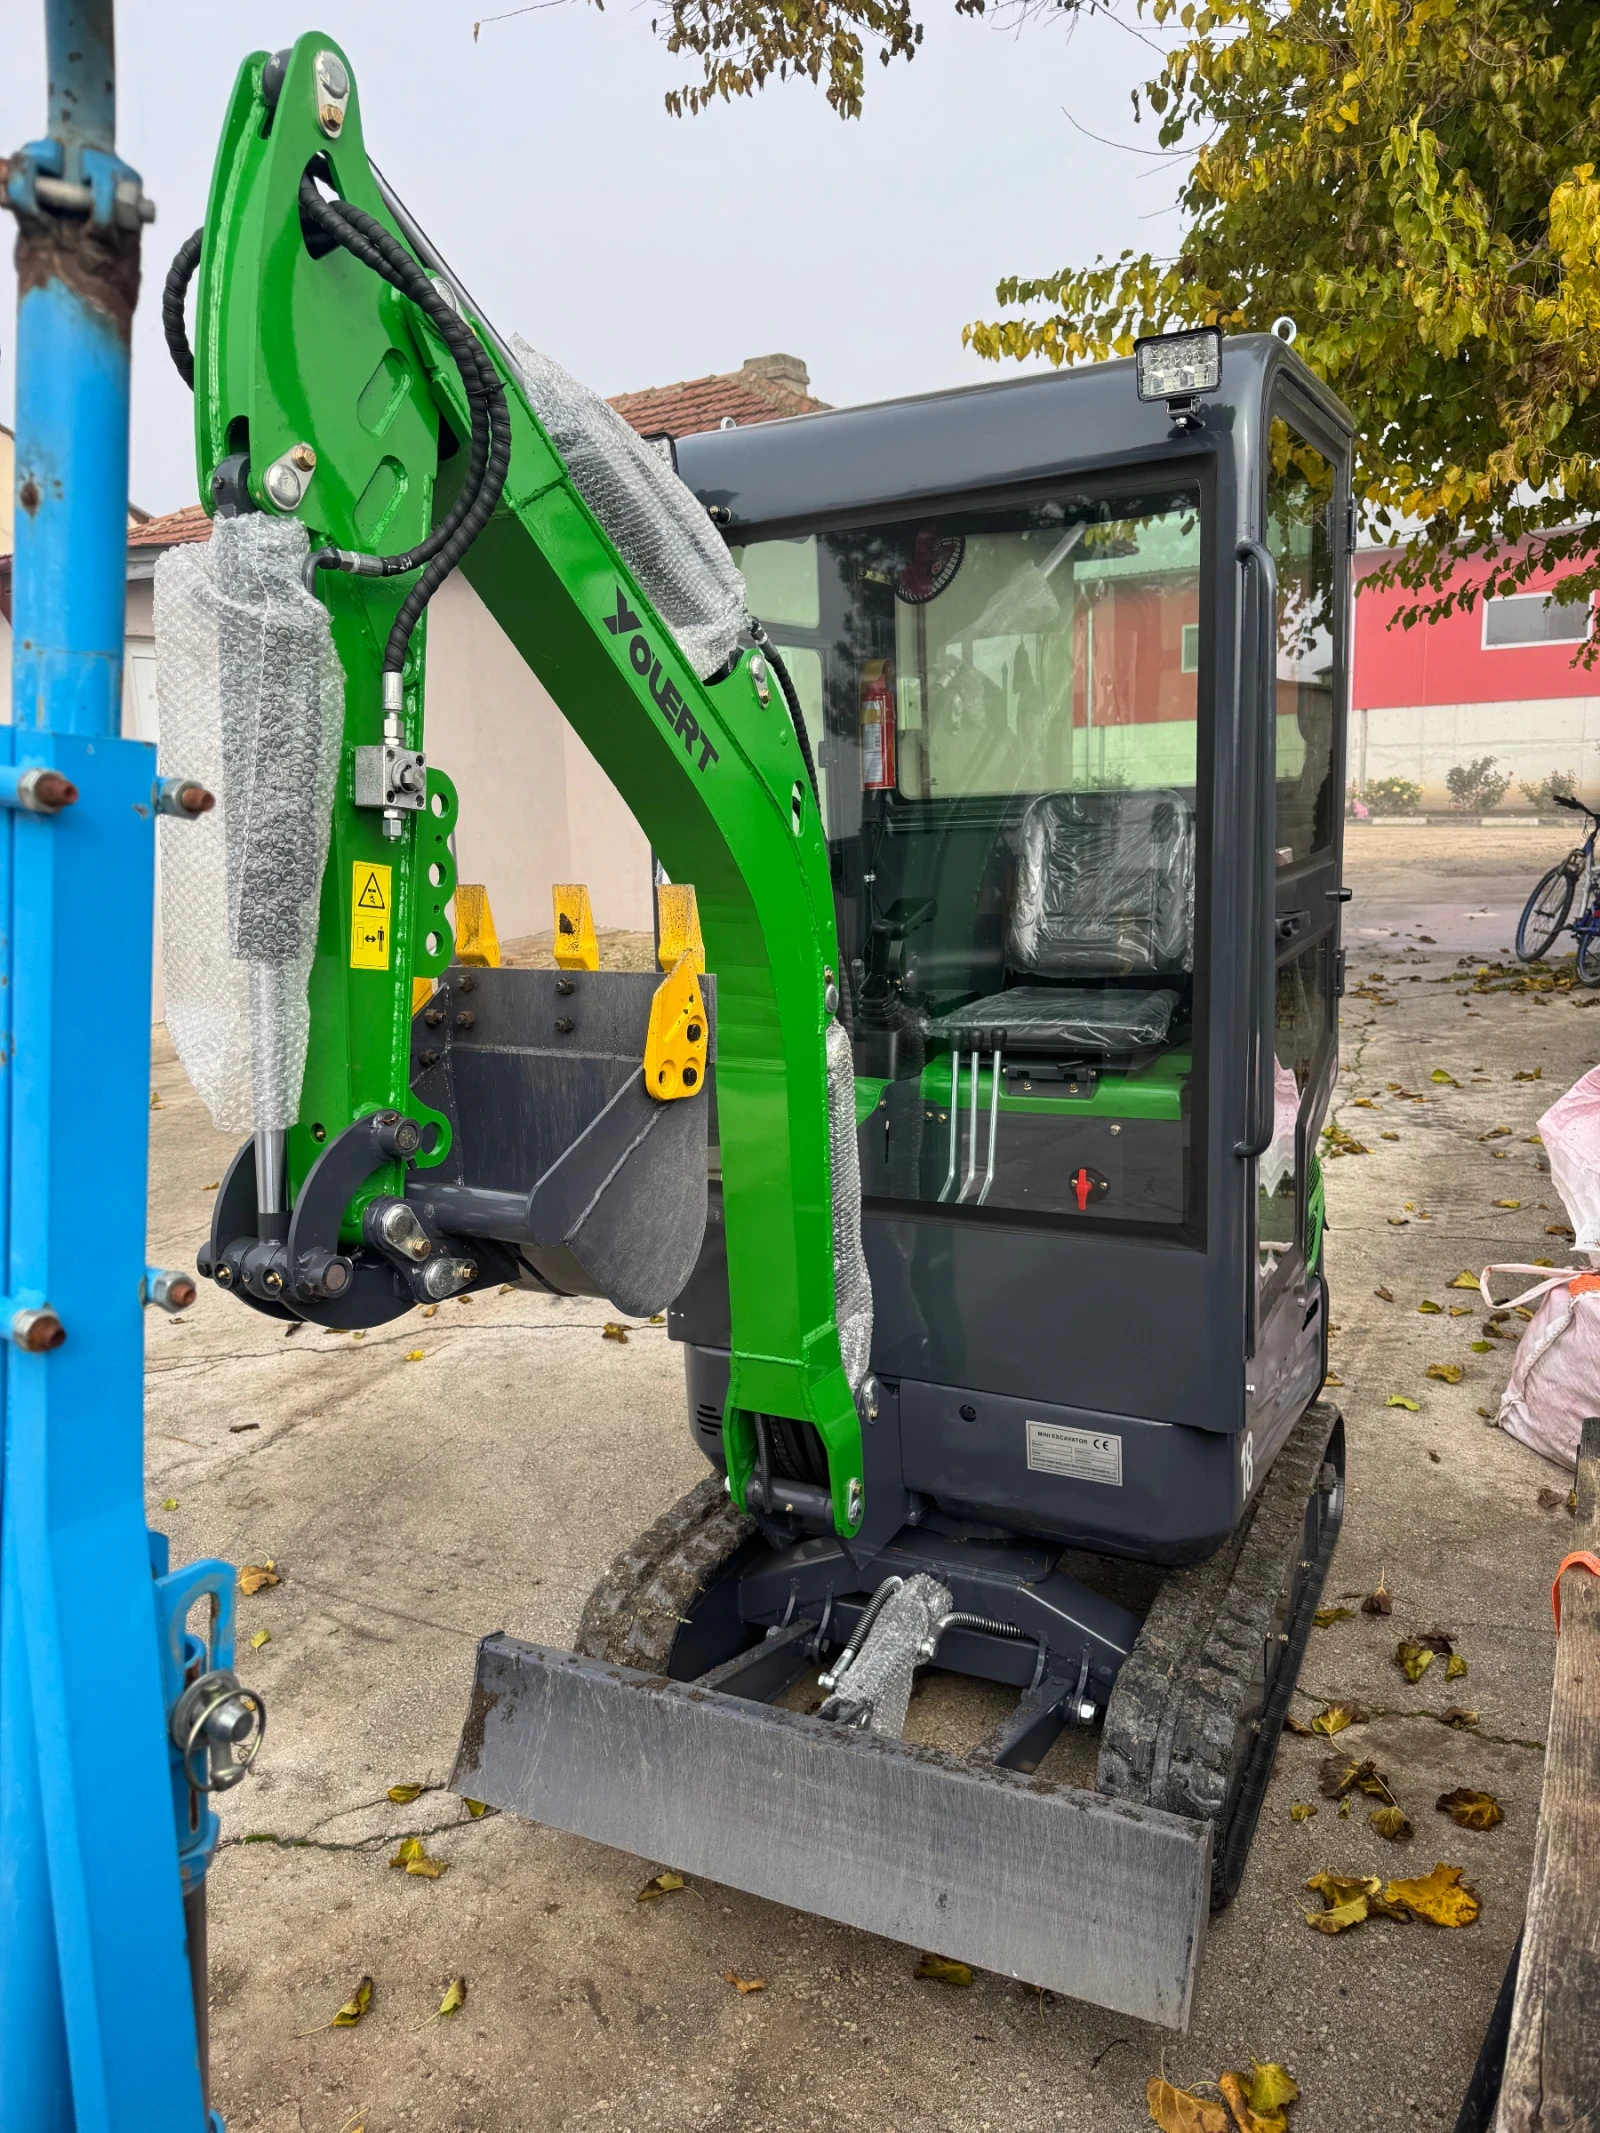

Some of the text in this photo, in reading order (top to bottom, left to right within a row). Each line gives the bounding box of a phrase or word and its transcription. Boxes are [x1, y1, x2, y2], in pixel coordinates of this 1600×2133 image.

[602, 584, 720, 774] YOUERT
[1037, 1431, 1051, 1439] MINI
[1051, 1434, 1088, 1445] EXCAVATOR
[1093, 1439, 1110, 1451] CE
[1240, 1430, 1254, 1502] 18
